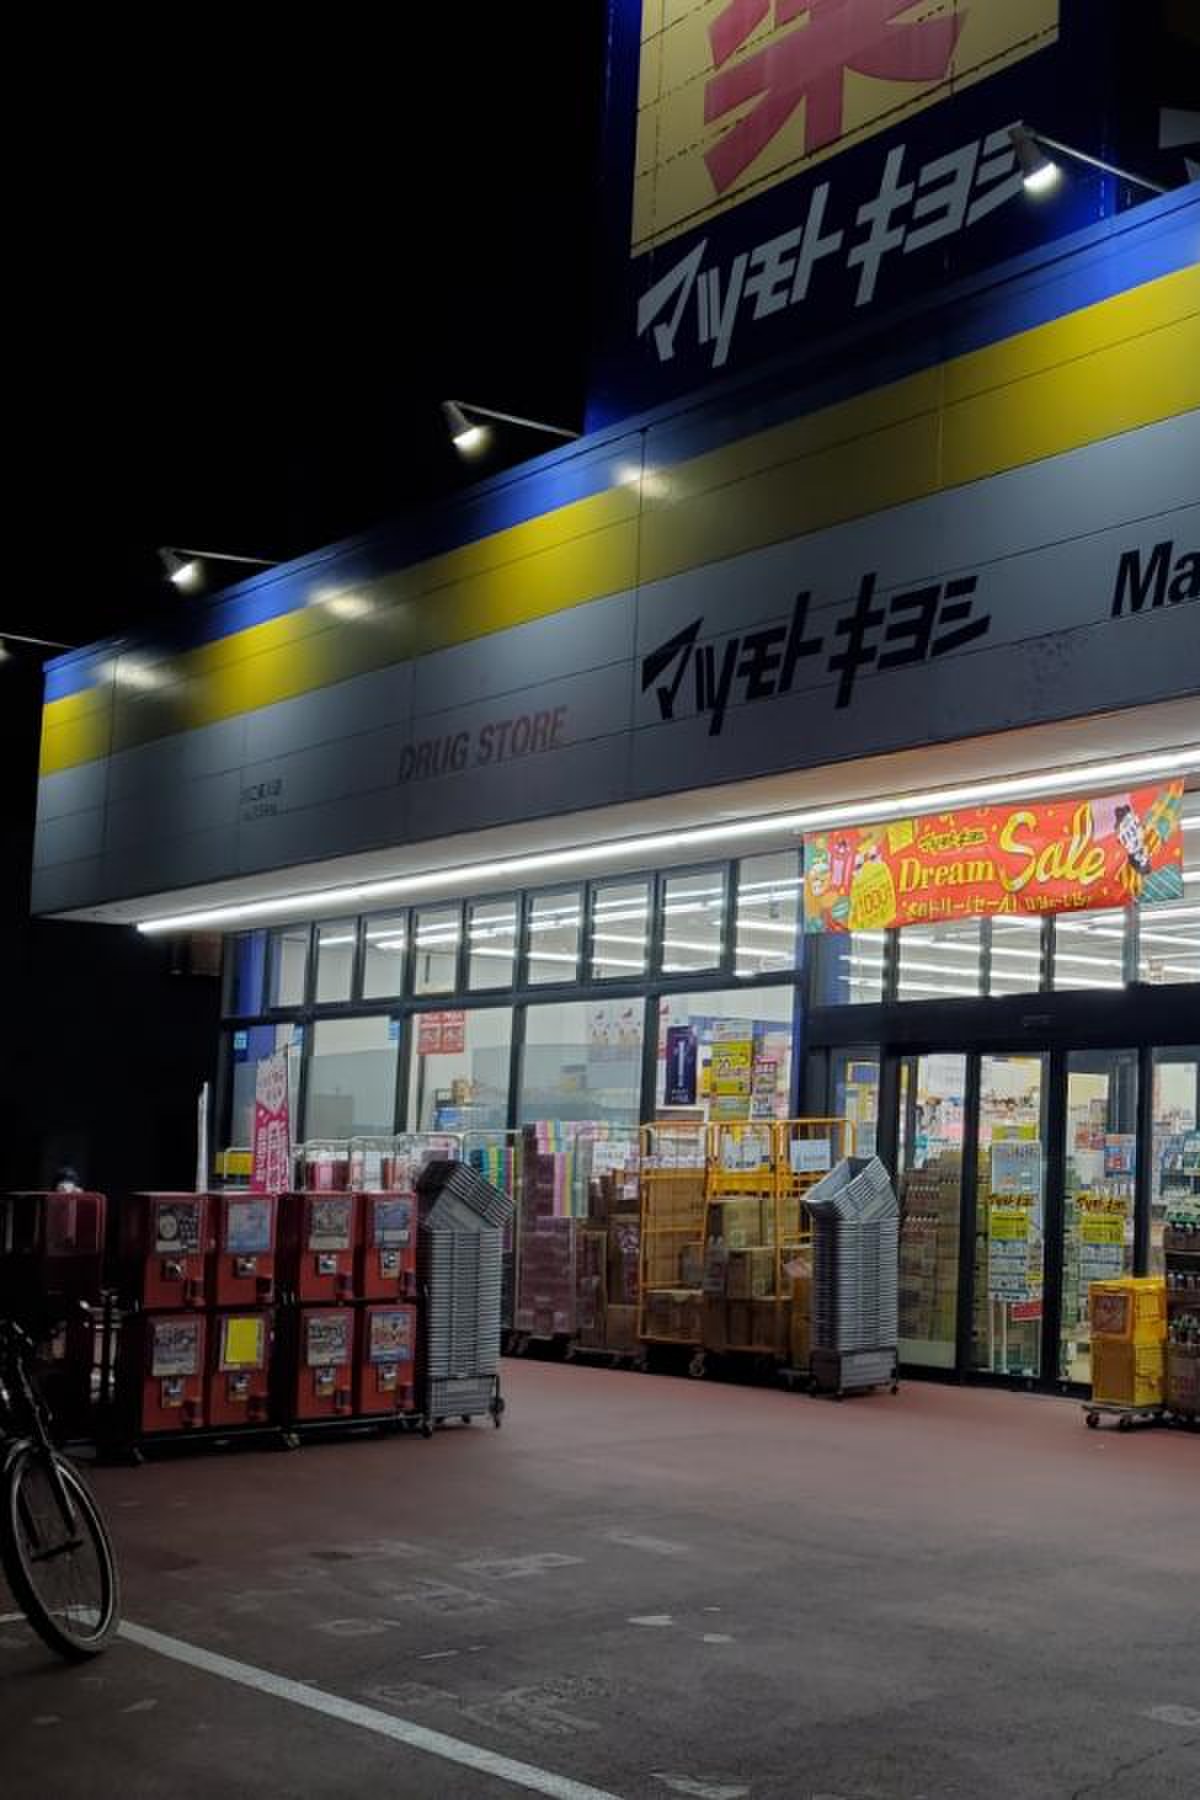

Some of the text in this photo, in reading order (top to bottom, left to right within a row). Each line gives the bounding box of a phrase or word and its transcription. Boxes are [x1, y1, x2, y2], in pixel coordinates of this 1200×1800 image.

[638, 120, 1024, 367] マツモトキヨシ
[642, 571, 990, 736] マツモトキヨシ
[400, 705, 567, 781] DRUG STORE
[899, 802, 1105, 896] Dream Sale
